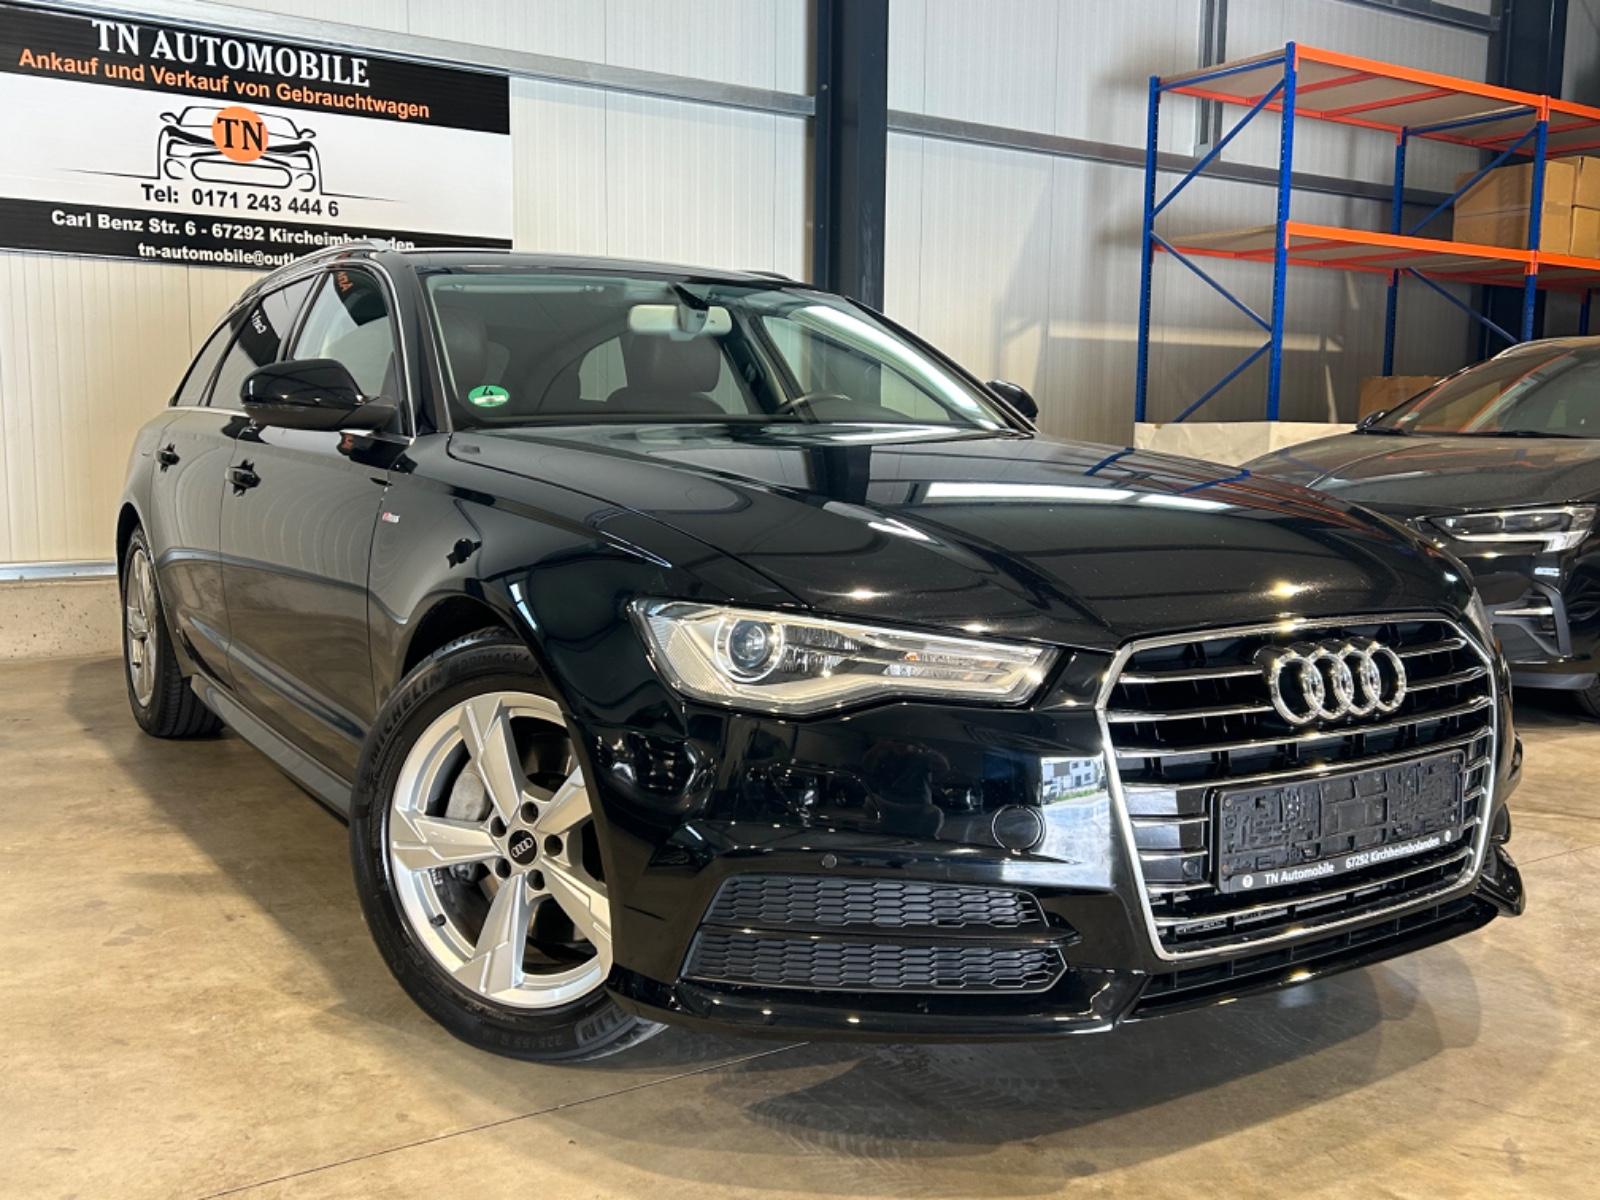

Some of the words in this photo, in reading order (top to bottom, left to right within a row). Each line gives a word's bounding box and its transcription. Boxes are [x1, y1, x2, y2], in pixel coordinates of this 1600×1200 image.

[92, 19, 141, 56] TN
[150, 30, 370, 87] AUTOMOBILE
[19, 48, 99, 76] Ankauf
[104, 63, 145, 82] und
[150, 65, 229, 93] Verkauf
[234, 80, 270, 98] von
[275, 82, 430, 119] Gebrauchtwagen
[217, 117, 264, 151] TN
[141, 183, 179, 203] Tel:
[191, 188, 238, 209] 0171
[247, 193, 281, 212] 243
[288, 198, 322, 216] 444
[328, 201, 339, 217] 6
[51, 210, 91, 228] Carl
[97, 214, 143, 232] Benz
[148, 218, 180, 234] Str.
[185, 220, 196, 236] 6
[212, 223, 265, 241] 67292
[138, 242, 301, 266] tn-automobile@outl
[1264, 871, 1279, 885] TN
[1281, 861, 1335, 883] Automobile
